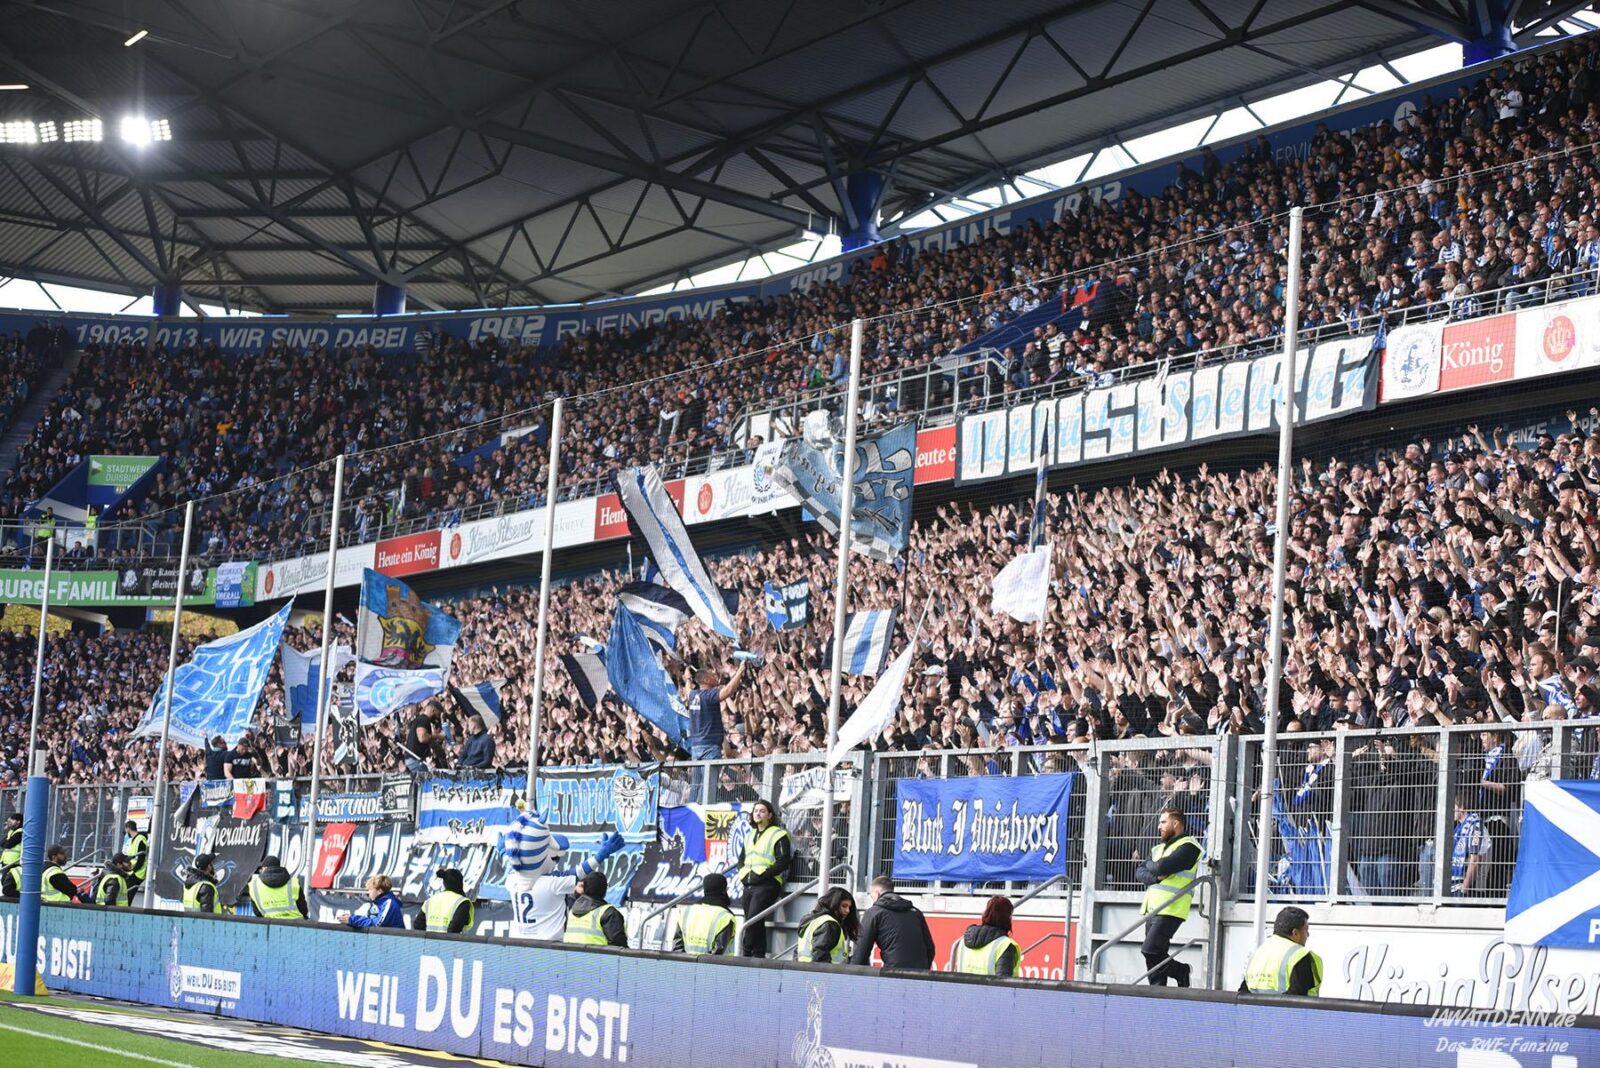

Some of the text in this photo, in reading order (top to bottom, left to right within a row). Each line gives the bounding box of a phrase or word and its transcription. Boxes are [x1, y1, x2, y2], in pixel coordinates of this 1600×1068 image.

[220, 327, 265, 349] WIR
[271, 329, 328, 350] SIND
[336, 327, 407, 350] DABEI
[1441, 338, 1504, 374] König
[378, 544, 438, 569] Heute ein König
[970, 798, 1060, 864] Duisburg
[514, 892, 537, 924] 12
[50, 937, 93, 981] BIST!
[202, 973, 214, 989] DU
[214, 978, 223, 990] ES
[336, 954, 631, 1063] WEIL DU ES BIST!
